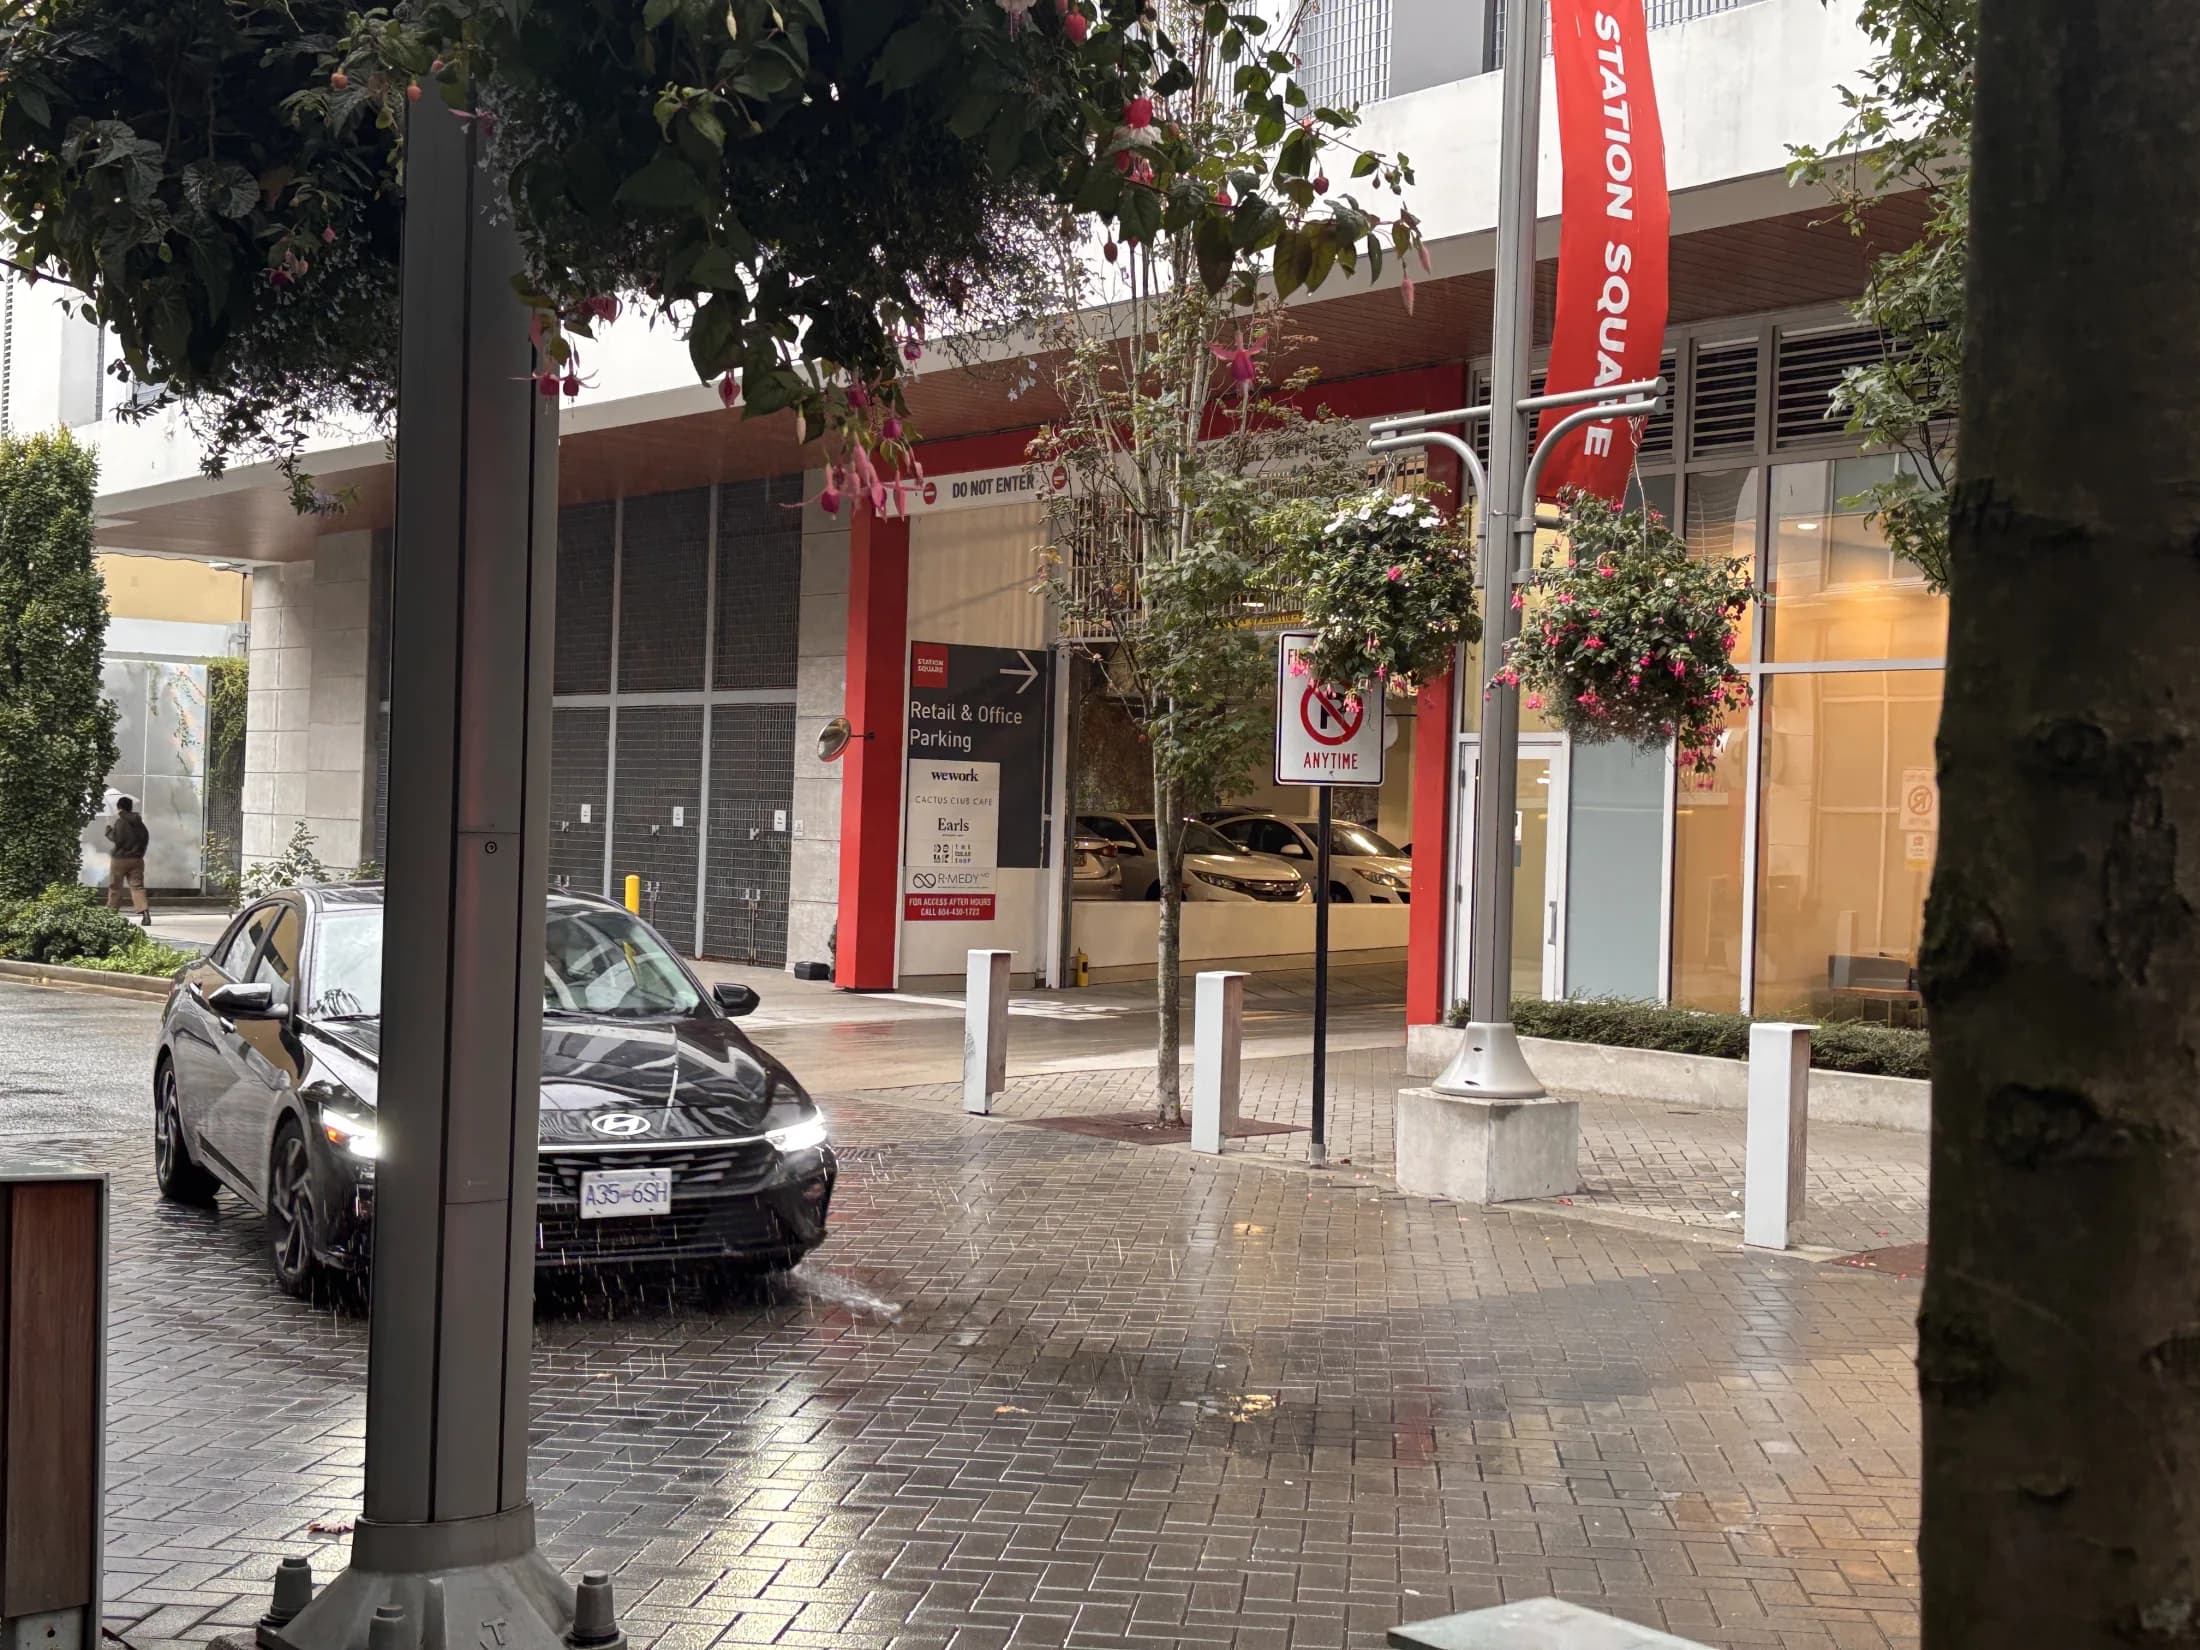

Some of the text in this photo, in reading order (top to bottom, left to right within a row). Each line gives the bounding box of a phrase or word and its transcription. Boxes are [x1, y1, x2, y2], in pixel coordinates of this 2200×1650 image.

[1583, 11, 1633, 457] STATION SQUAE
[952, 475, 1034, 498] DO NOT ENTER
[911, 701, 1022, 724] Retail & Office
[910, 728, 972, 752] Parking
[1304, 752, 1358, 769] ANYTIME
[931, 768, 979, 782] wework
[915, 795, 948, 805] CACTUS
[950, 797, 970, 806] CLUB
[938, 817, 969, 832] Earls
[909, 897, 992, 906] FOR ACCESS AFTER HOURS
[920, 907, 936, 916] CALL
[586, 1182, 668, 1205] A35-6SH
